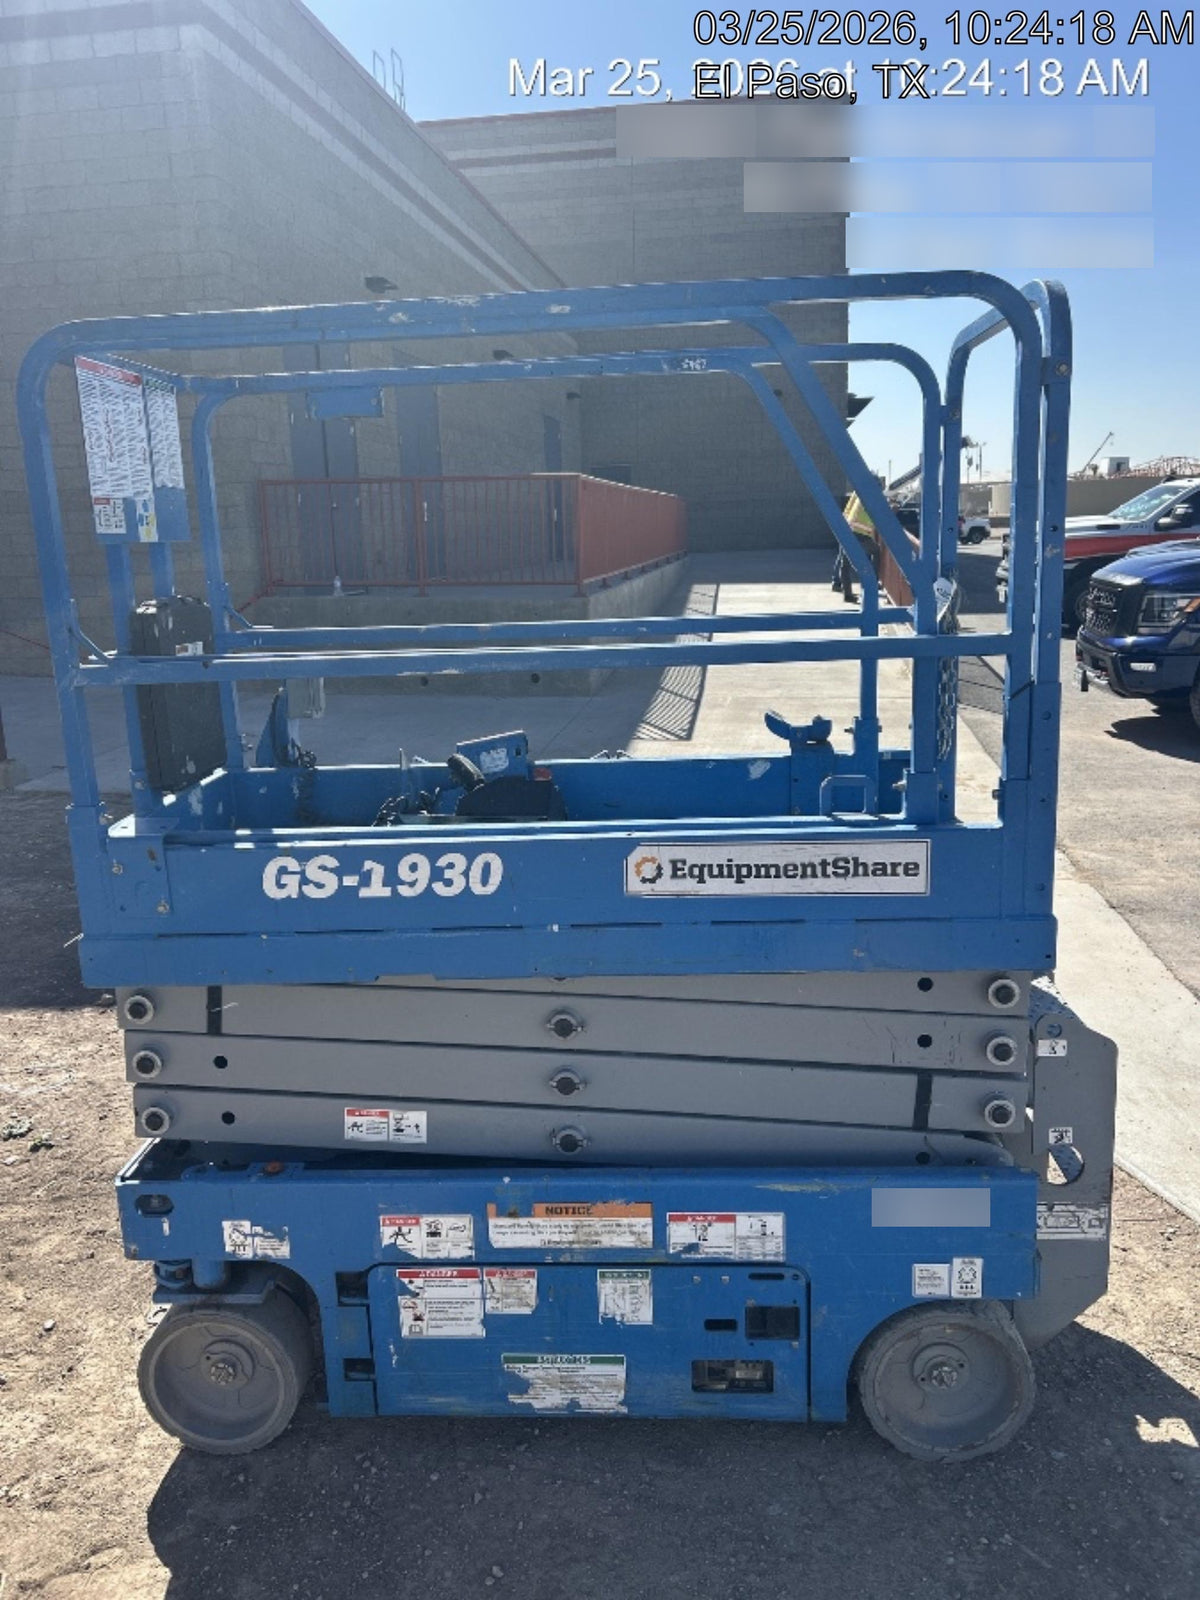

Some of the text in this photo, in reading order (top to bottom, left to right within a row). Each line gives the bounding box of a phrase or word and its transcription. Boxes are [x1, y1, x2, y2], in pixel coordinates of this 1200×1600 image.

[262, 853, 504, 900] GS-1930
[668, 857, 920, 884] EquipmentShare
[545, 1205, 594, 1216] NOTICE
